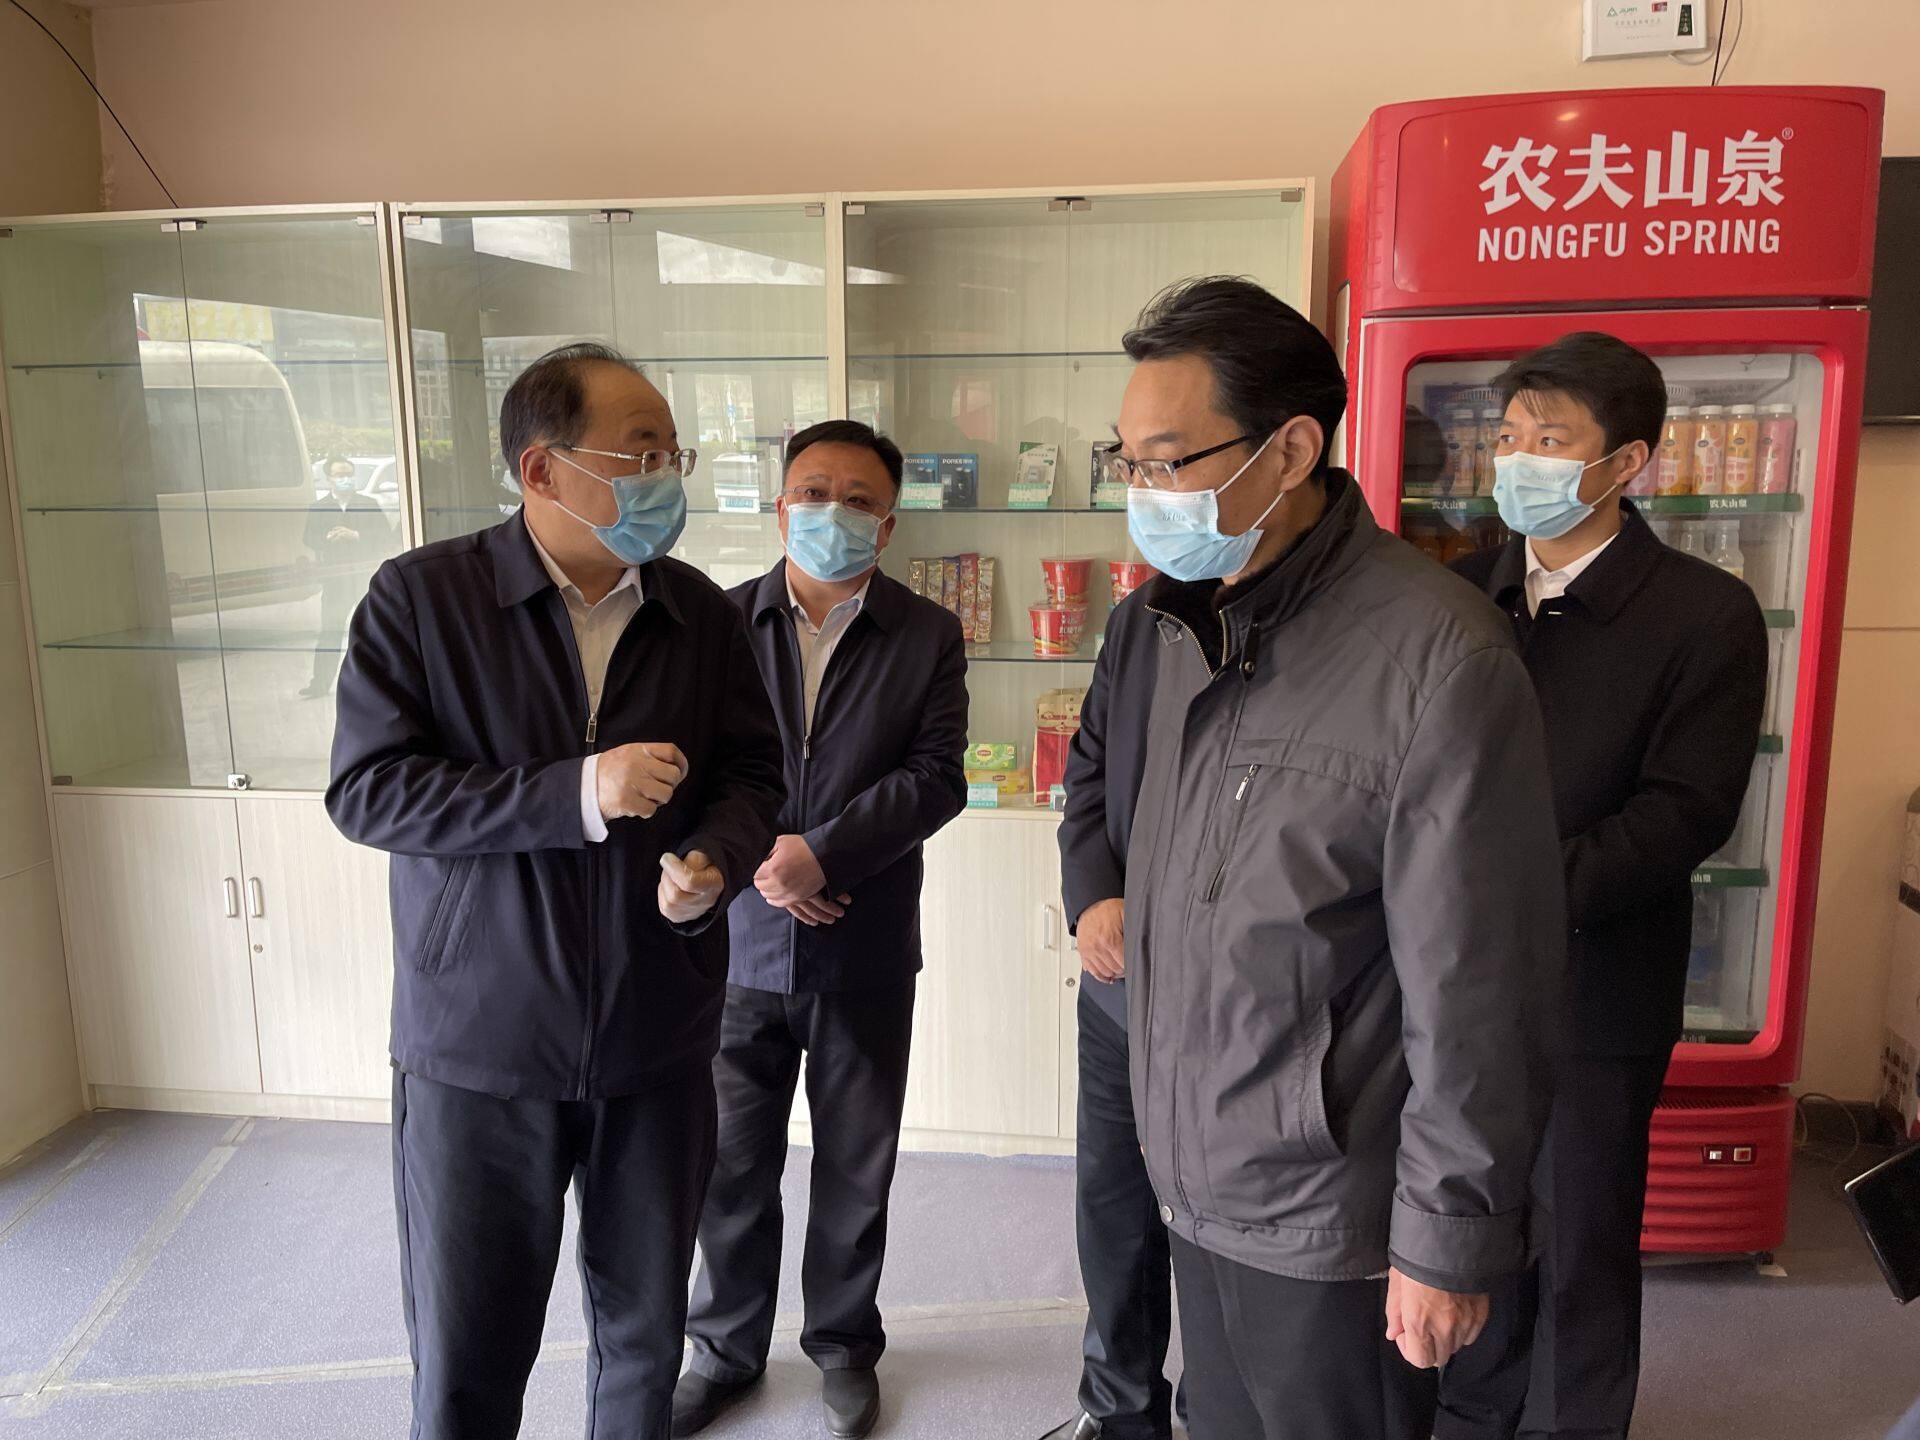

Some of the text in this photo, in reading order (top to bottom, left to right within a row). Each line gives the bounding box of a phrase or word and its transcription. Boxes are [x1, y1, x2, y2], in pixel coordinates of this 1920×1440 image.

[1478, 129, 1785, 216] 农夫山泉
[1477, 218, 1781, 263] NONGFU SPRING
